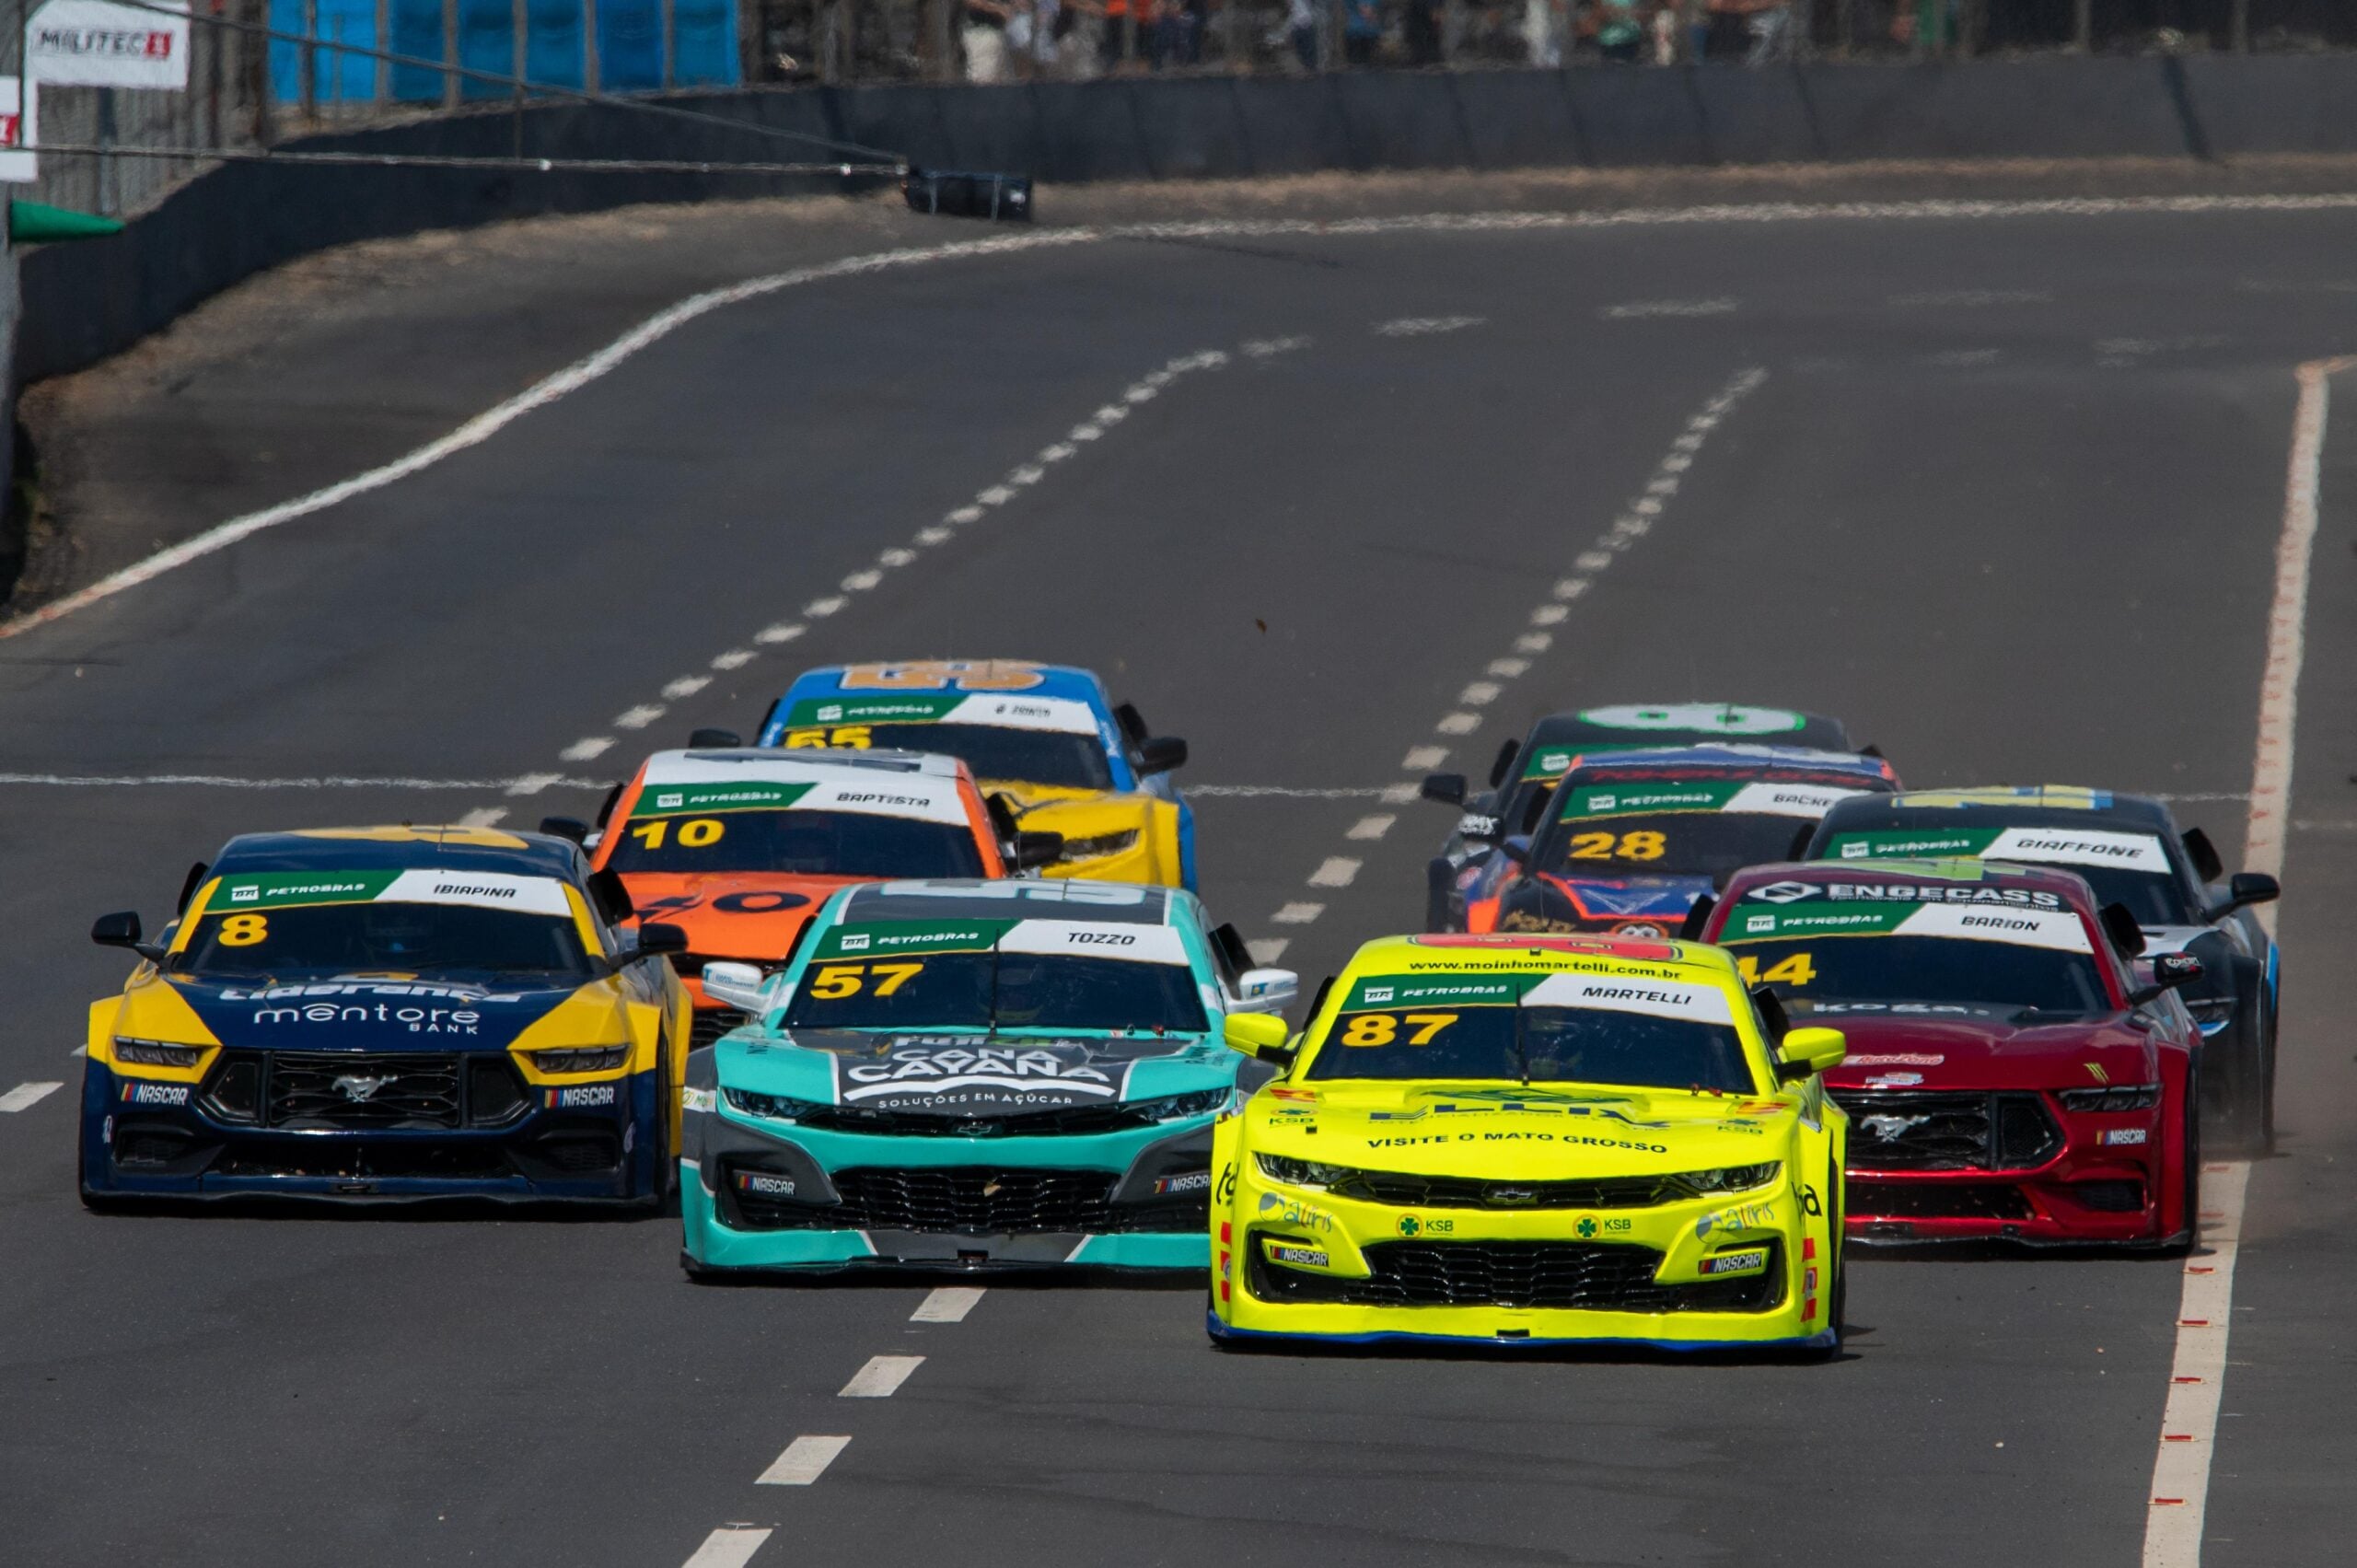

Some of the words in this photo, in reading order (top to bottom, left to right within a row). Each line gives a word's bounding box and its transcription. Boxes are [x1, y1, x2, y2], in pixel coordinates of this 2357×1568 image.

[837, 792, 930, 807] BAPTISTA
[633, 819, 725, 849] 10
[1569, 830, 1666, 861] 28
[2016, 839, 2143, 859] GIAFFONE
[266, 883, 366, 896] PETROBRAS
[434, 884, 517, 898] IBIAPINA
[1828, 884, 2060, 906] ENGECASS
[1782, 915, 1883, 927] PETROBRAS
[1961, 915, 2040, 932] BARION
[218, 913, 268, 947] 8
[877, 932, 980, 945] PETROBRAS
[1068, 932, 1136, 946] TOZZO
[1410, 959, 1681, 980] www.moinhomartelli.com.br
[810, 964, 923, 999] 57
[1402, 985, 1507, 997] PETROBRAS
[1583, 987, 1691, 1005] MARTELLI
[410, 1023, 478, 1035] BANK
[1341, 1014, 1458, 1048] 87
[892, 1048, 1062, 1063] CANA
[848, 1059, 1110, 1082] CAYANA
[136, 1084, 188, 1105] NASCAR
[563, 1086, 614, 1106] NASCAR
[878, 1094, 967, 1109] SOLUÇÕES
[975, 1093, 995, 1101] EM
[1002, 1093, 1072, 1104] AÇÚCAR
[1270, 1117, 1315, 1125] KSB
[1367, 1135, 1449, 1148] VISITE
[1458, 1132, 1475, 1142] O
[1484, 1132, 1554, 1141] MATO
[1562, 1135, 1667, 1154] GROSSO
[2109, 1129, 2146, 1144] NASCAR
[752, 1177, 795, 1195] NASCAR
[1171, 1175, 1211, 1191] NASCA
[1426, 1220, 1454, 1231] KSB
[1604, 1218, 1631, 1230] KSB
[1283, 1248, 1328, 1266] NASCAR
[1714, 1253, 1761, 1272] NASCAR
